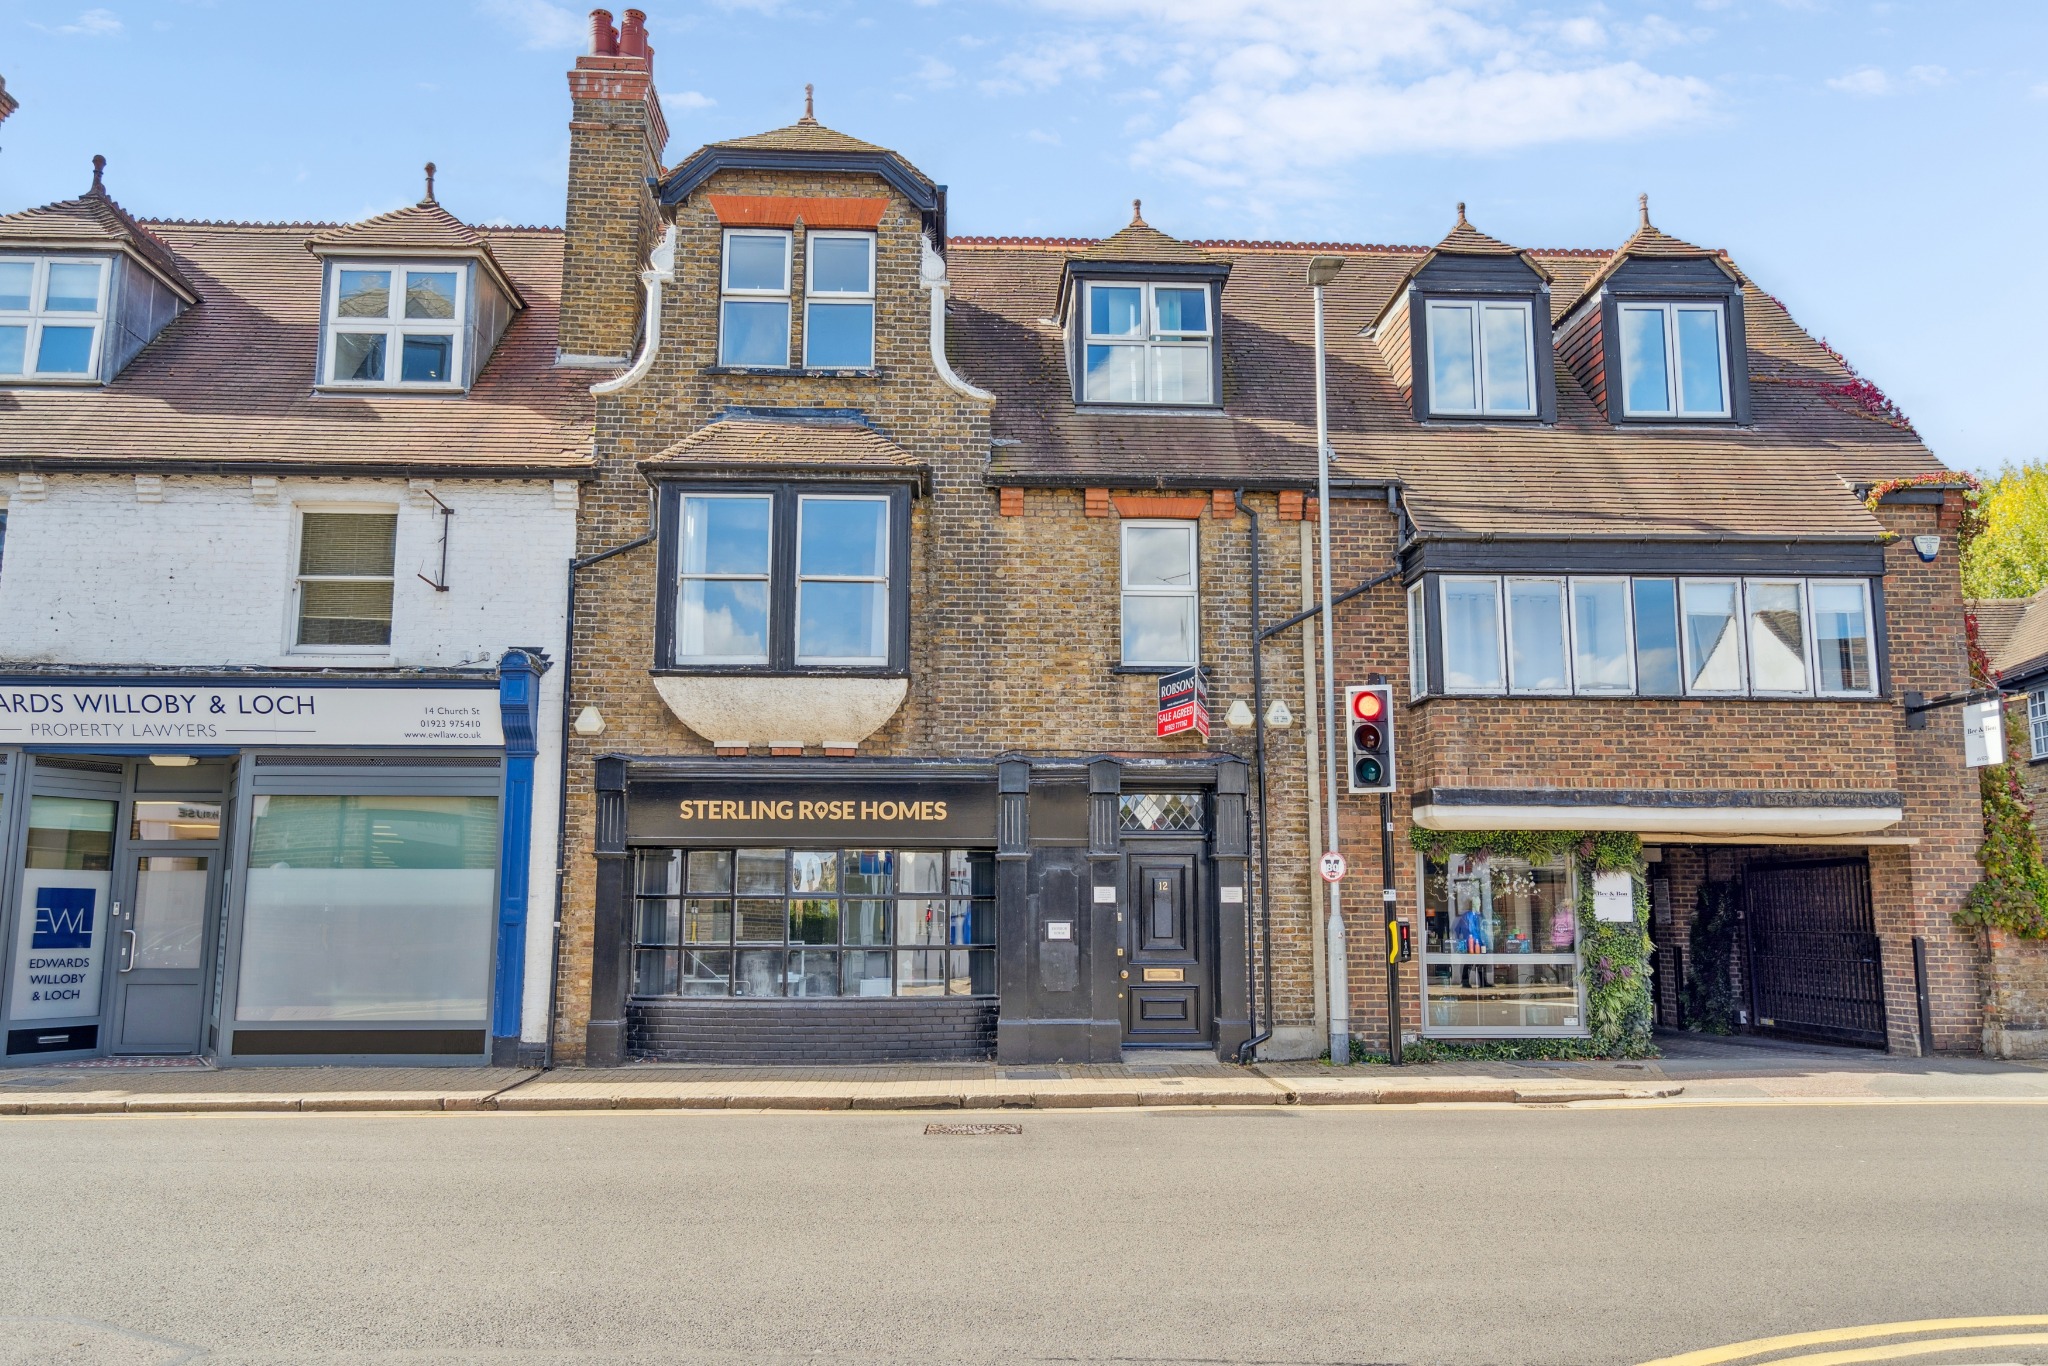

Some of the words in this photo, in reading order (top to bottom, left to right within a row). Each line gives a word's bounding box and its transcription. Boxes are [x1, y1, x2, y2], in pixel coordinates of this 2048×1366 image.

[1161, 677, 1195, 698] ROBSONS
[73, 694, 197, 714] WILLOBY
[209, 695, 227, 714] &
[238, 694, 315, 715] LOCH
[424, 706, 435, 716] 14
[437, 706, 469, 716] Church
[471, 707, 481, 716] St
[1158, 711, 1173, 724] SALE
[1172, 705, 1194, 721] AGREED
[420, 719, 447, 728] 01923
[449, 719, 481, 728] 975410
[30, 723, 124, 737] PROPERTY
[132, 723, 218, 738] LAWYERS
[403, 730, 482, 739] www.ewllaw.co.uk
[680, 800, 794, 820] STERLING
[861, 801, 948, 821] HOMES
[1158, 881, 1169, 891] 12
[34, 907, 93, 934] EWL
[29, 957, 90, 969] EDWARDS
[30, 973, 87, 985] WILLOBY
[32, 991, 41, 1002] &
[44, 989, 81, 1001] LOCH
